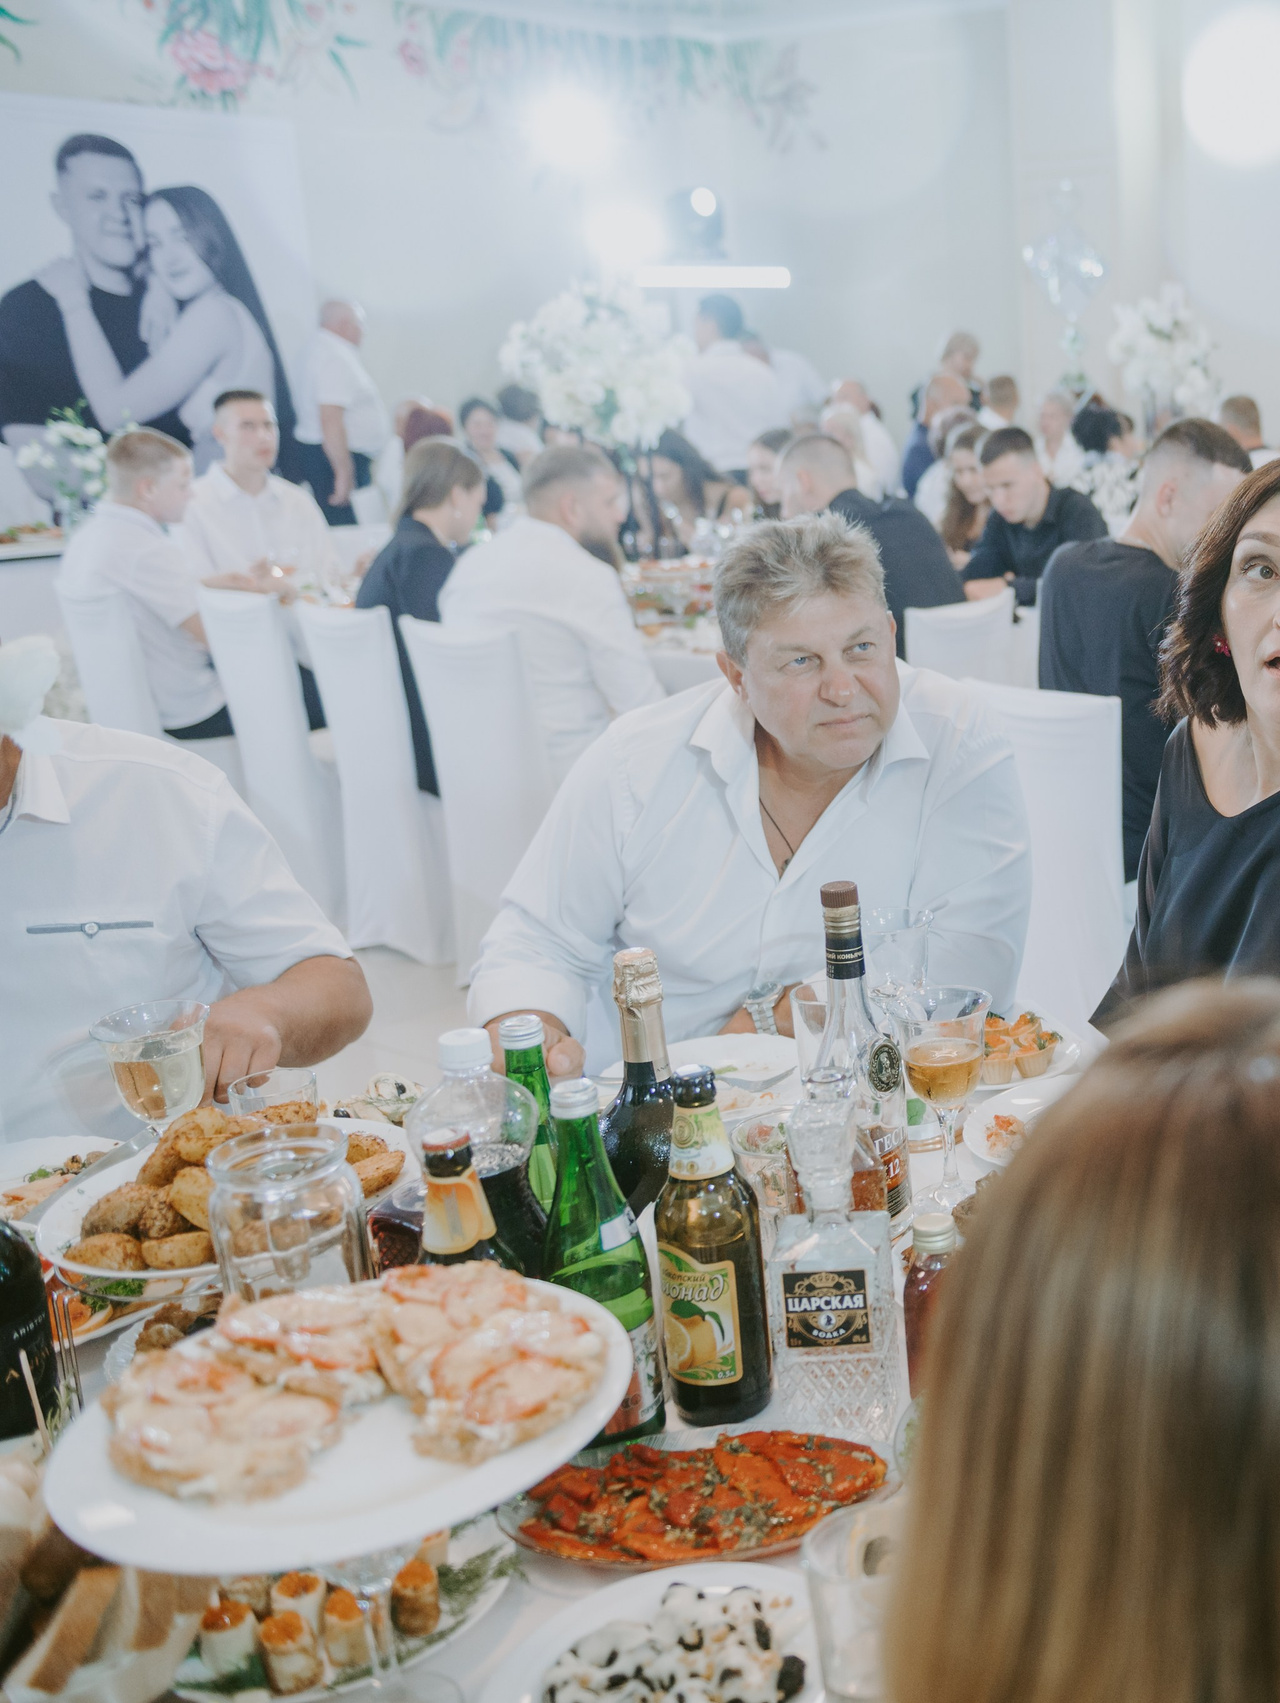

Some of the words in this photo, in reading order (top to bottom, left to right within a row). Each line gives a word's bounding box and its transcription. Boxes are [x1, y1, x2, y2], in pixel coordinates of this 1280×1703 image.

[837, 950, 863, 960] КОНЬЯЧ
[888, 1158, 900, 1178] 12
[787, 1294, 864, 1312] ЦАРСКАЯ
[812, 1328, 846, 1339] ВОДКА
